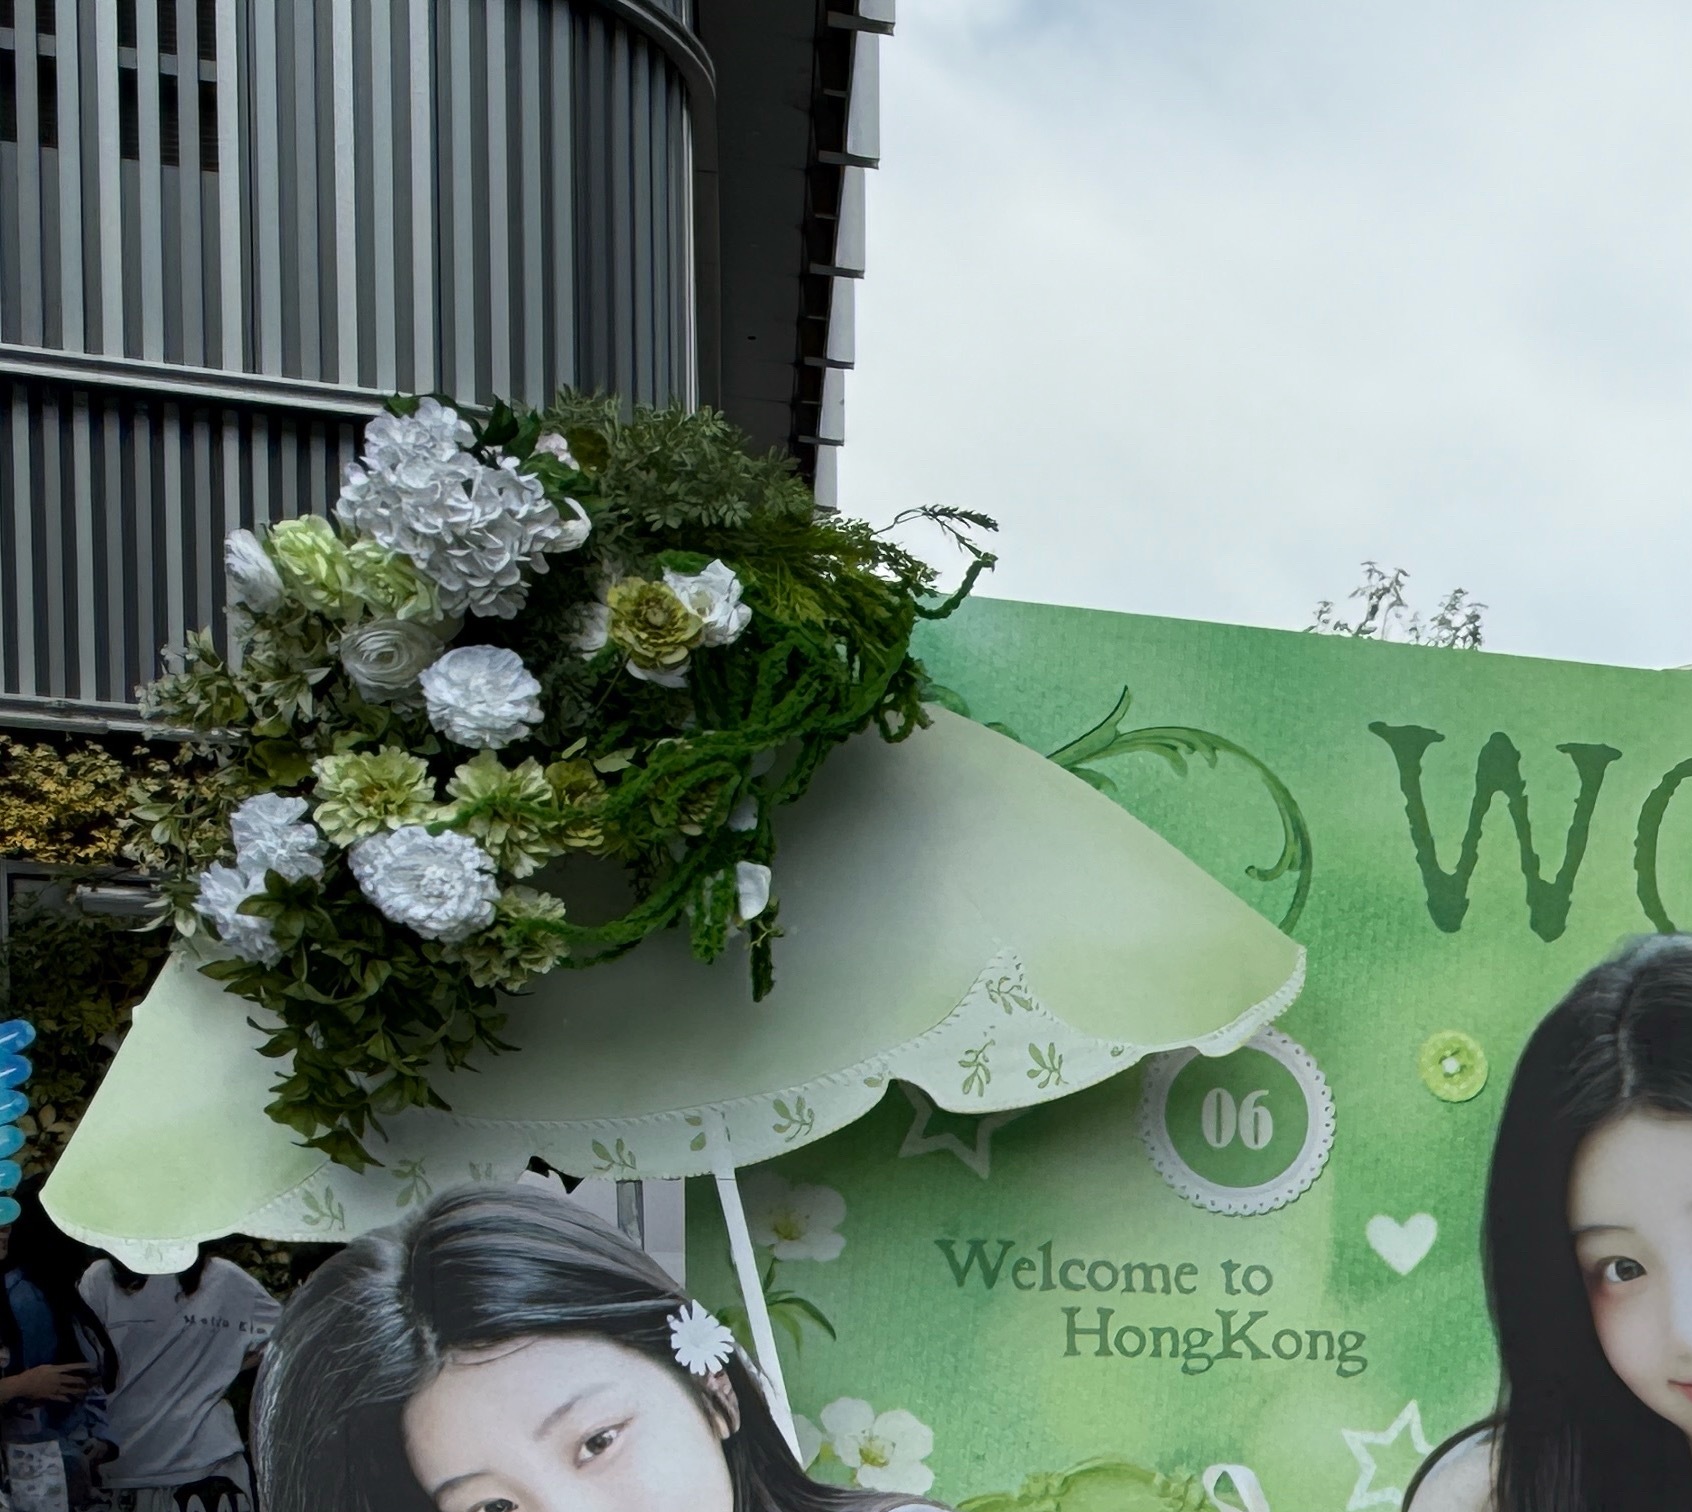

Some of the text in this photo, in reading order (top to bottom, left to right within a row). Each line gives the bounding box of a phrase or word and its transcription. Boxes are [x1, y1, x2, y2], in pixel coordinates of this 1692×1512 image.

[1201, 1087, 1274, 1150] 06
[934, 1238, 1274, 1297] Welcome to
[1060, 1306, 1369, 1378] HongKong
